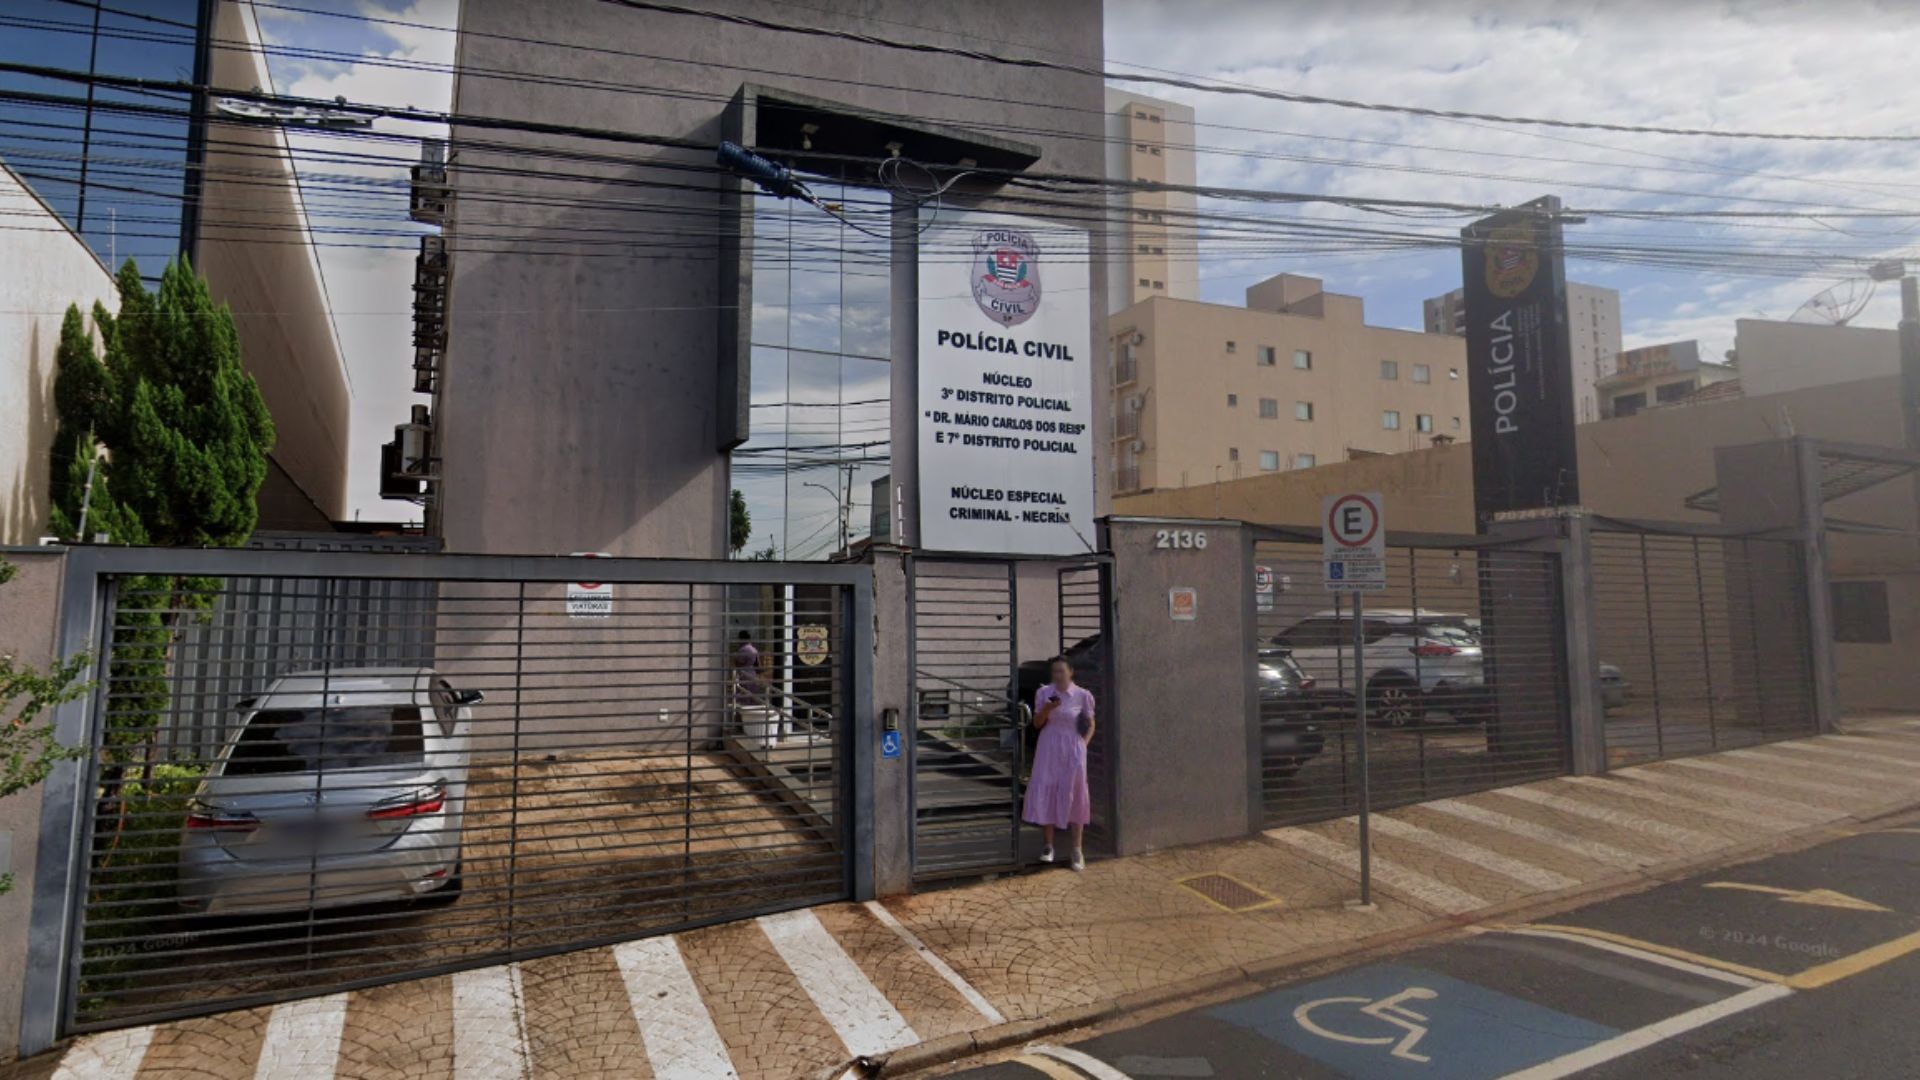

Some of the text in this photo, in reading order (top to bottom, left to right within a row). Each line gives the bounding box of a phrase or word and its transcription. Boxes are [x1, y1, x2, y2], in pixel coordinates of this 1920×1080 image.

[991, 300, 1025, 314] CIVIL
[938, 329, 1074, 361] POLÍCIA CIVIL
[983, 371, 1032, 389] NÚCLEO
[1490, 309, 1518, 434] POLÍCIA
[957, 390, 1014, 406] DISTRITO
[1017, 396, 1071, 411] POLICIAL
[955, 411, 989, 427] MÁRIO
[992, 416, 1033, 431] CARLOS
[1036, 421, 1056, 433] DOS
[936, 431, 944, 443] E
[963, 434, 1020, 449] DISTRITO
[1023, 439, 1077, 453] POLICIAL
[951, 485, 1066, 505] NÚCLEO ESPECIAL
[949, 507, 1012, 521] CRIMINAL
[1343, 507, 1362, 535] E
[1156, 530, 1207, 549] 2136
